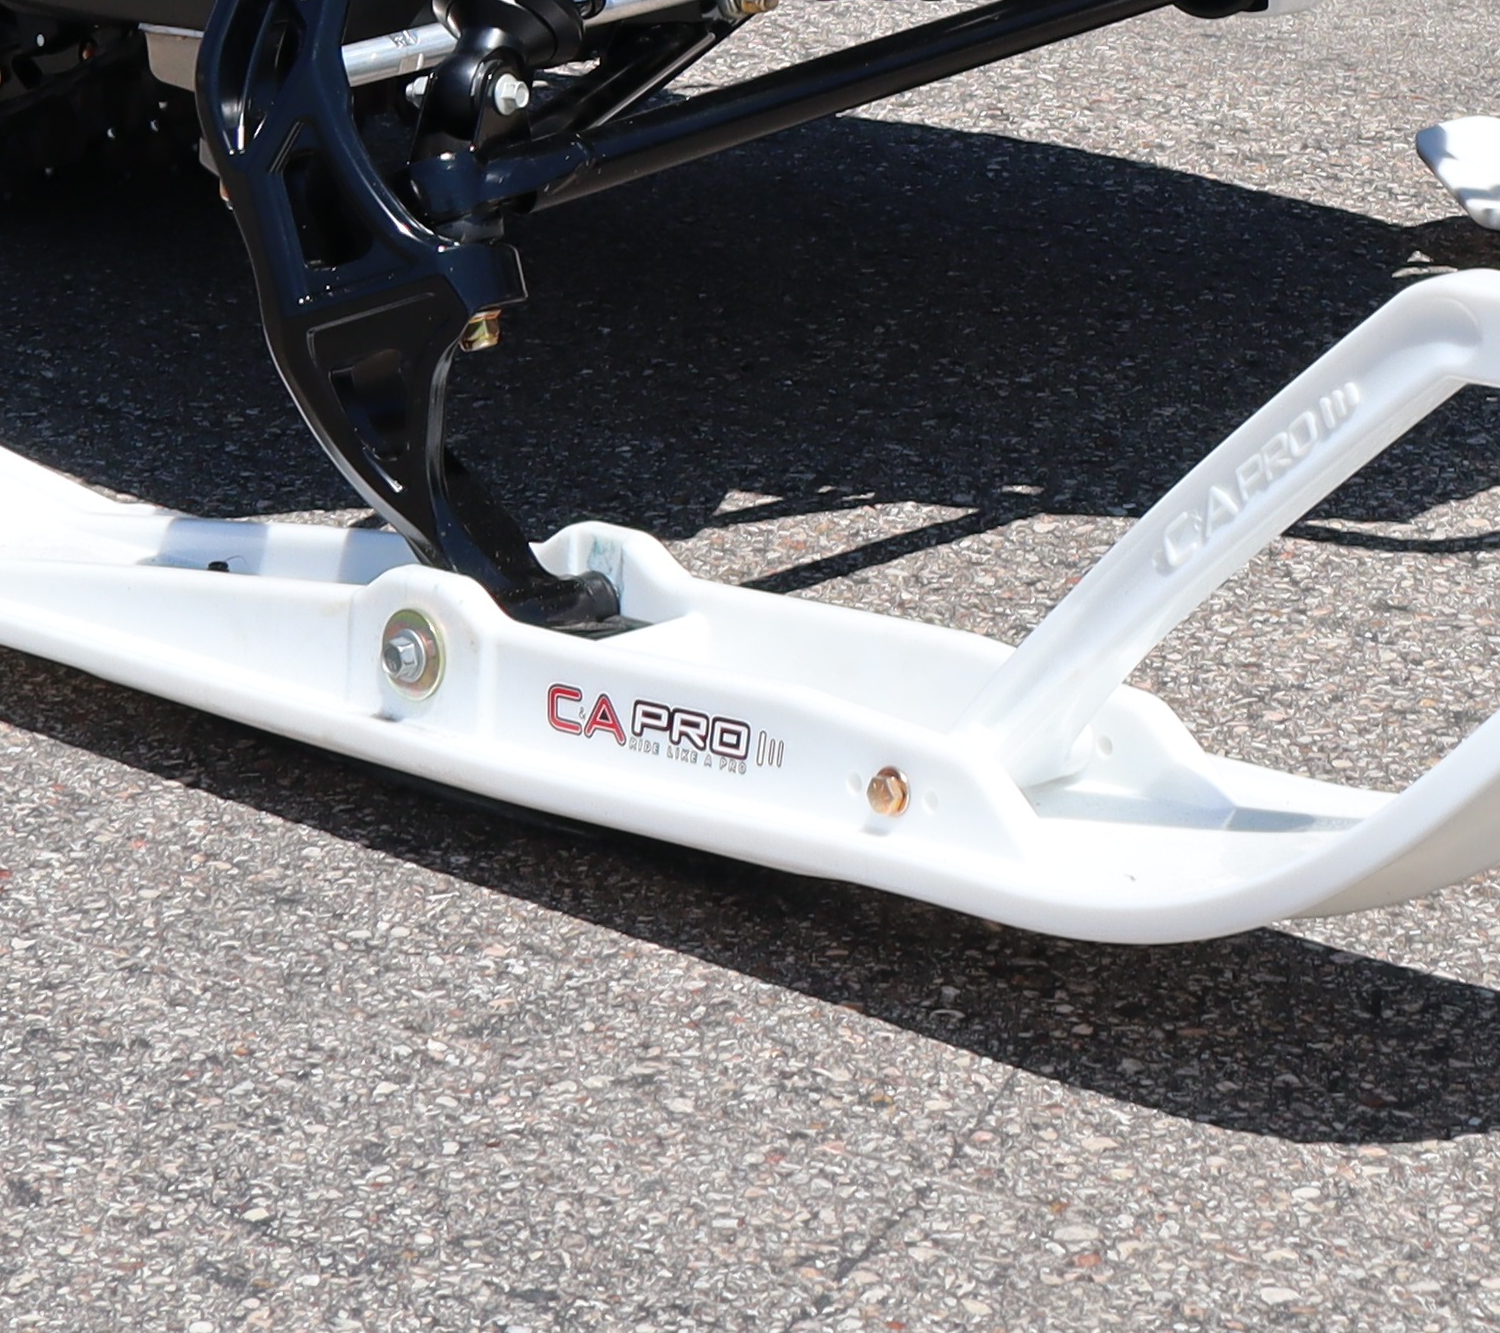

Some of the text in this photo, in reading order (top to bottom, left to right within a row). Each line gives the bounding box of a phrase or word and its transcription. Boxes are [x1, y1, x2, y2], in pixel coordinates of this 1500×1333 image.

[631, 699, 751, 761] PRO
[629, 737, 748, 775] RIDE LIKE A PRO
